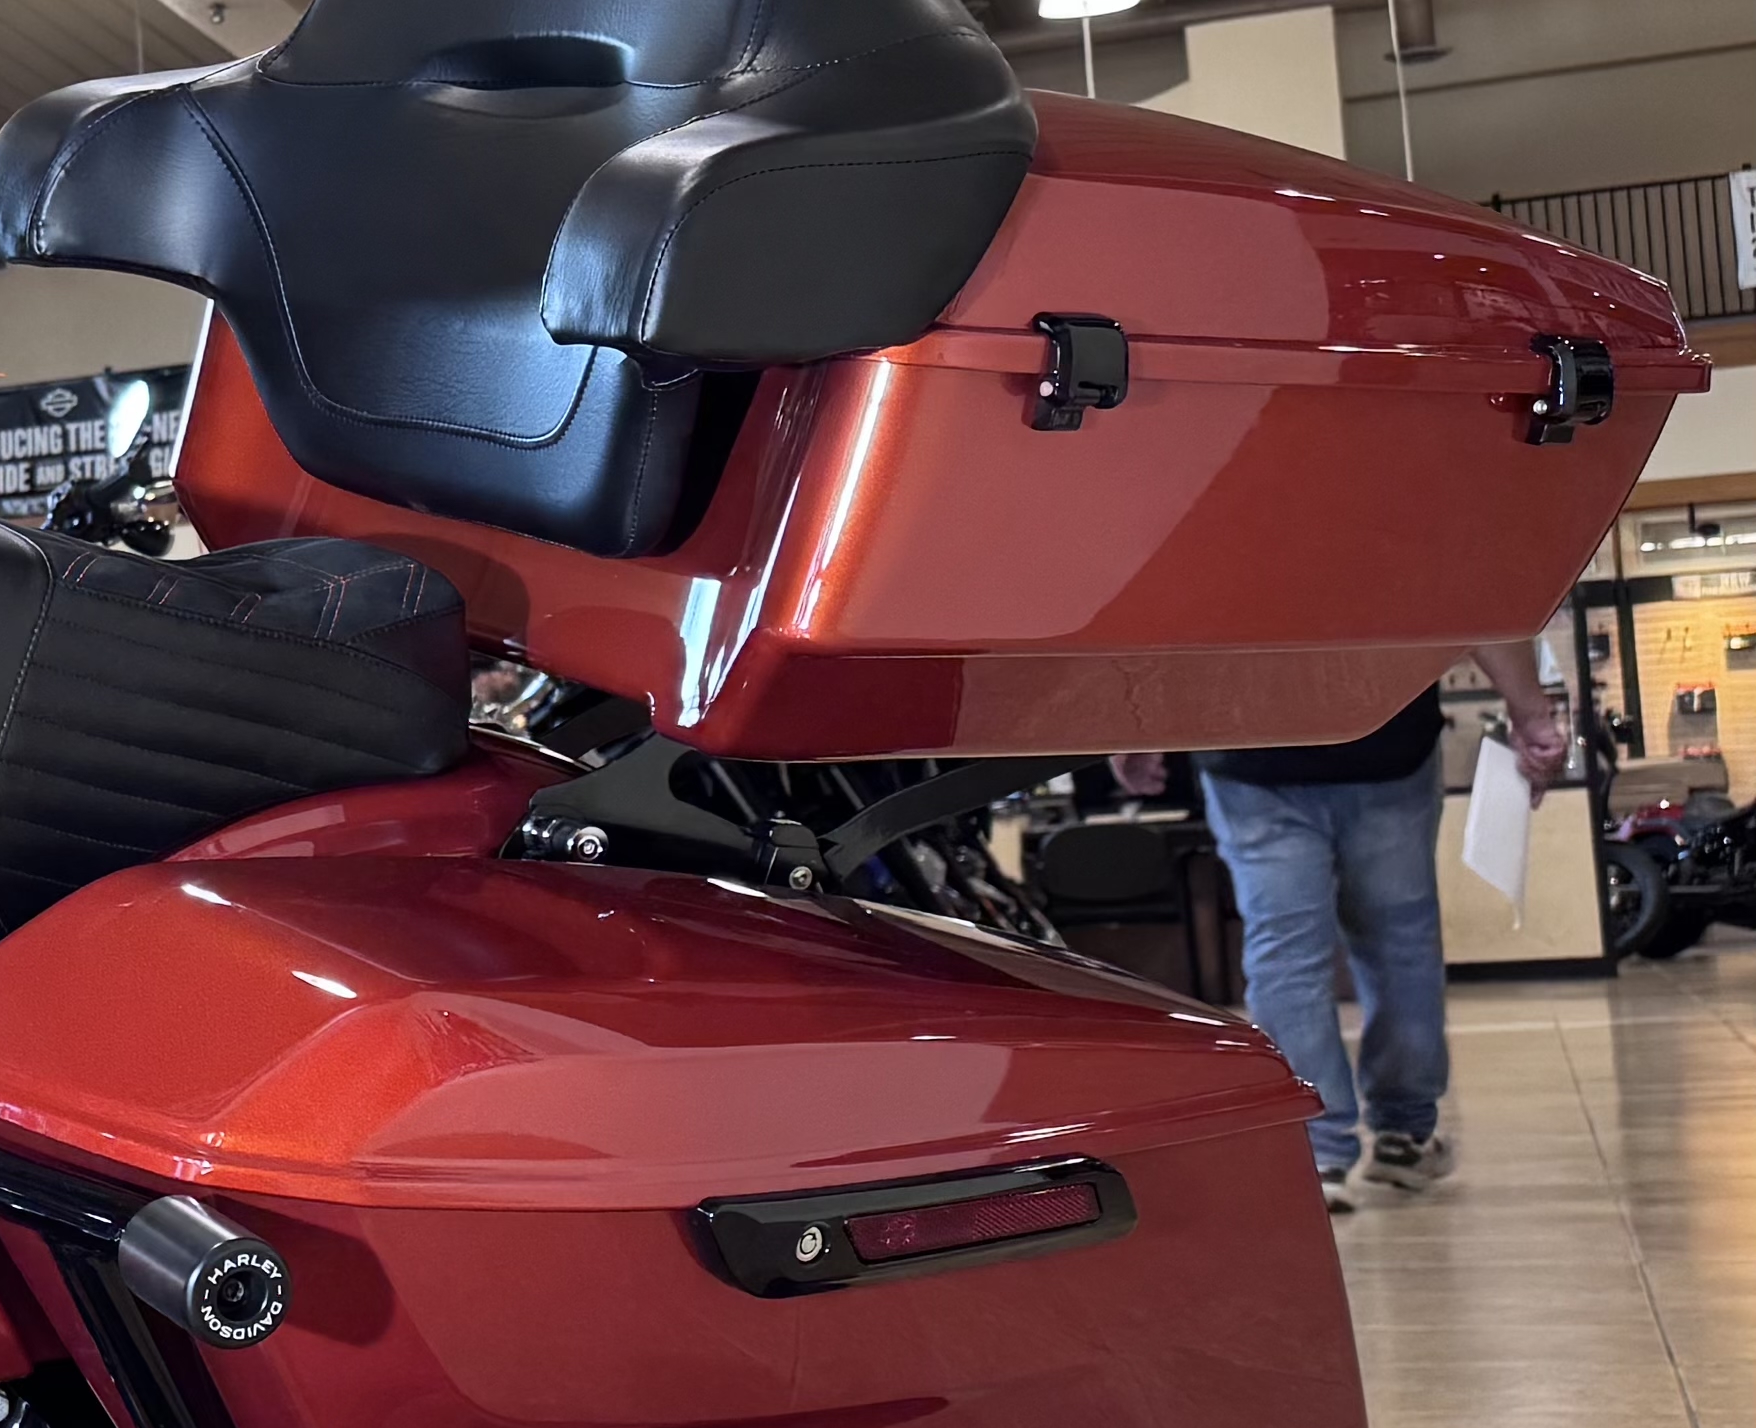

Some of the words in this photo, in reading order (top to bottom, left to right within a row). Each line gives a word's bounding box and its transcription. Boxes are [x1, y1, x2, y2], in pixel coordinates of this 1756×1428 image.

[66, 419, 106, 452] THE
[207, 1253, 283, 1285] HARLEY
[201, 1301, 283, 1340] DAVIDSON
